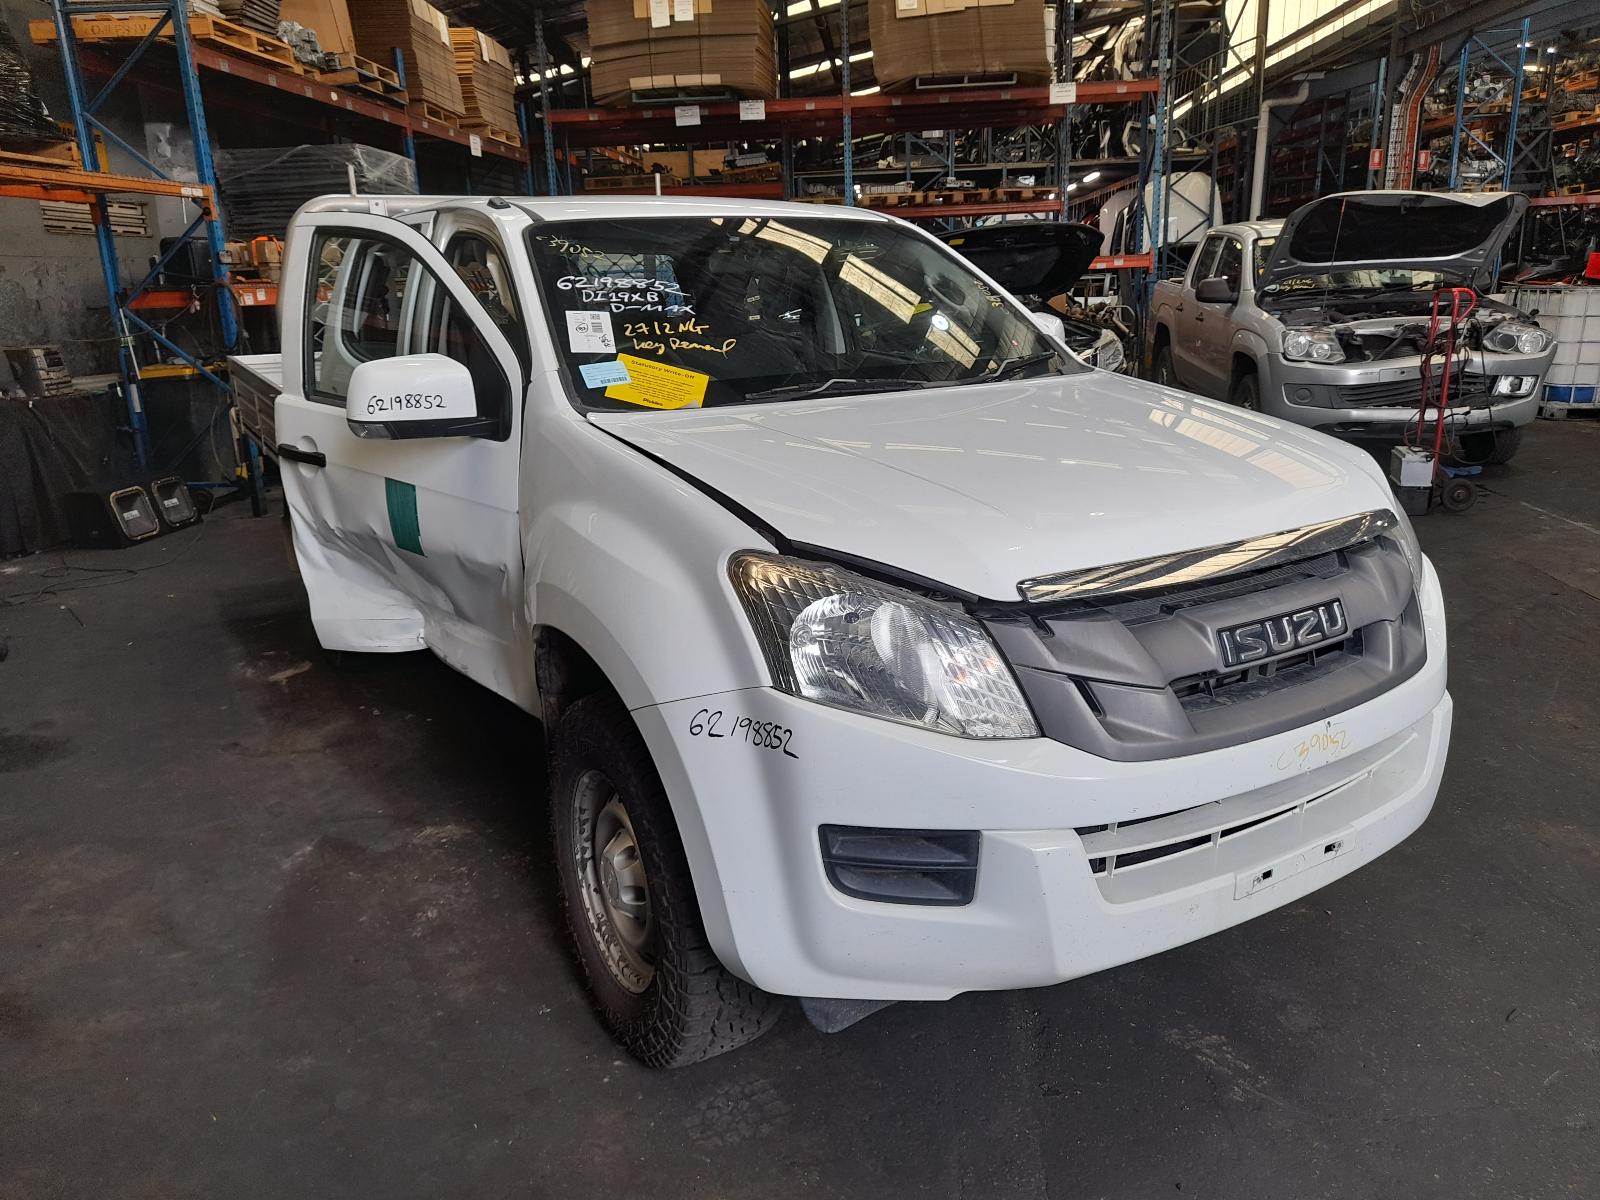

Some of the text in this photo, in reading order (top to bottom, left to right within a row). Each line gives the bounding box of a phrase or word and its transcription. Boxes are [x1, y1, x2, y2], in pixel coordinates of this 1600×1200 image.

[556, 275, 692, 297] 62198852
[631, 360, 696, 380] Statutory Write-Off
[366, 393, 448, 415] 62198852
[1220, 601, 1347, 664] ISUZU
[689, 708, 800, 759] 62198852
